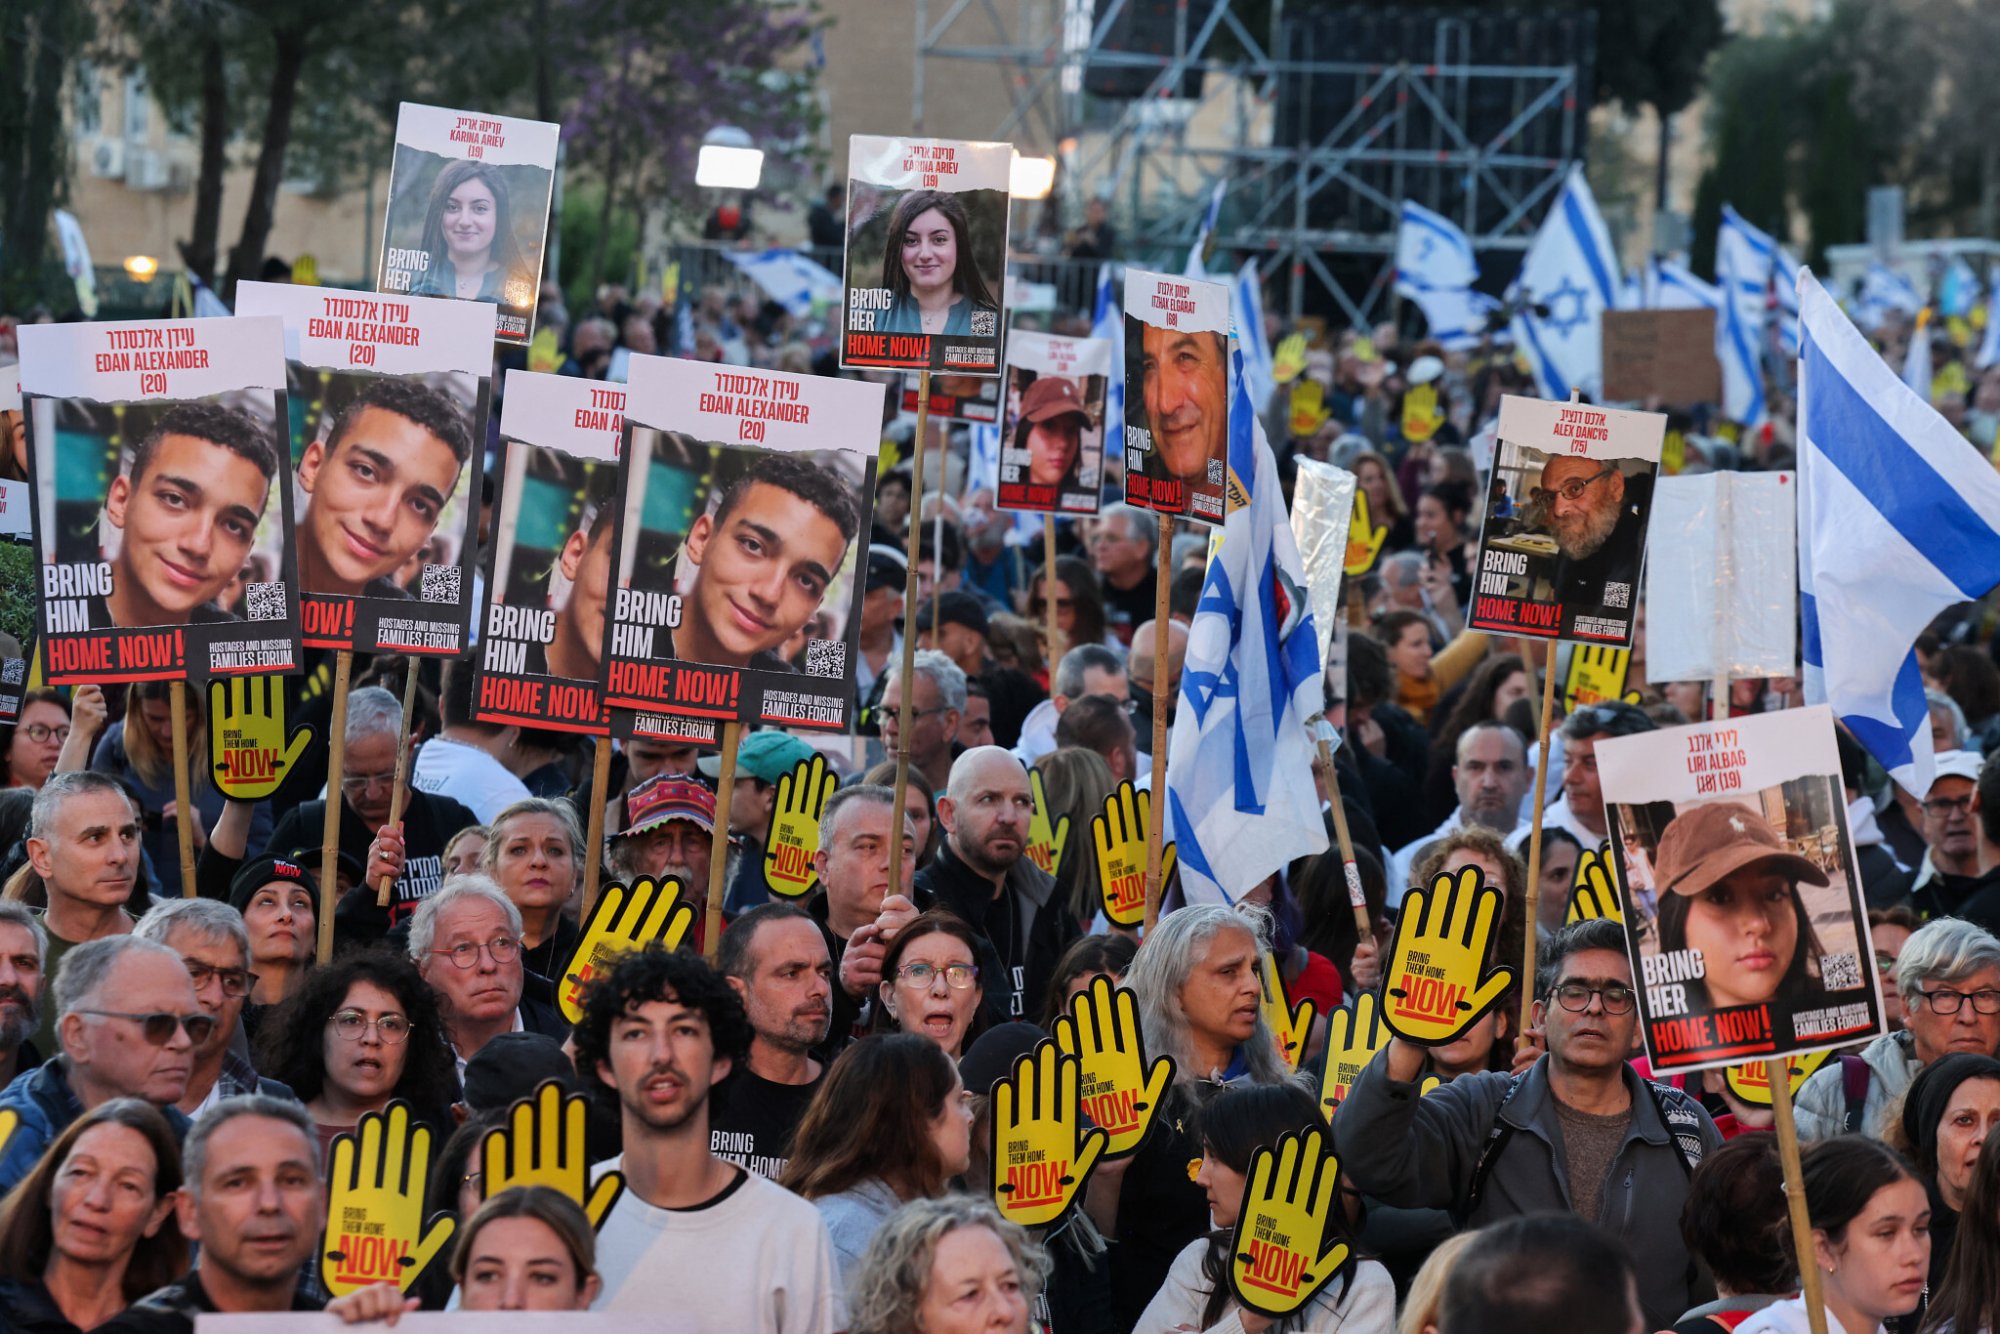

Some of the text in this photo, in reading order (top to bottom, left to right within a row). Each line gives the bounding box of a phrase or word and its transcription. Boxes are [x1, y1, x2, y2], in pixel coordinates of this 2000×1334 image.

[449, 129, 505, 148] KARINA ARIEV
[468, 144, 483, 159] (19)
[903, 159, 958, 174] KARINA ARIEV
[923, 173, 938, 188] (19)
[387, 247, 429, 271] BRING
[384, 269, 411, 291] HER
[850, 287, 892, 310] BRING
[324, 298, 409, 323] עידן אלכסנדר
[849, 310, 875, 331] HER
[106, 328, 195, 349] עידן אלכסנדר
[308, 318, 420, 346] EDAN ALEXANDER
[350, 344, 376, 366] (20)
[847, 334, 930, 359] HOME NOW!
[95, 349, 209, 372] EDAN ALEXANDER
[945, 353, 995, 364] FAMILIES FORUM
[140, 373, 167, 395] (20)
[714, 372, 799, 401] עידן אלכסנדר
[590, 389, 627, 411] כסנדר
[699, 393, 810, 424] EDAN ALEXANDER
[574, 408, 607, 431] EDAN
[739, 419, 765, 442] (20)
[1127, 425, 1151, 451] BRING
[1553, 423, 1608, 441] ALEX DANCYG
[1571, 439, 1587, 454] (75)
[1127, 447, 1143, 472] HIM
[1128, 472, 1182, 504] HOME NOW!
[1483, 550, 1528, 575] BRING
[42, 562, 113, 598] BRING
[1479, 572, 1509, 596] HIM
[46, 599, 90, 633] HIM
[614, 588, 683, 628] BRING
[1476, 596, 1562, 627] HOME NOW!
[378, 617, 460, 634] HOSTAGES AND MISSING
[487, 604, 556, 644] BRING
[47, 629, 185, 672] HOME NOW!
[209, 638, 291, 653] HOSTAGES AND MISSING
[377, 628, 459, 650] FAMILIES FORUM
[610, 623, 654, 659] HIM
[210, 649, 293, 669] FAMILIES FORUM
[483, 639, 527, 675] HIM
[480, 676, 544, 715] HOME
[607, 660, 740, 708] HOME NOW!
[763, 689, 844, 708] HOSTAGES AND MISSING
[762, 701, 843, 724] FAMILIES FORUM
[223, 730, 242, 739] BRING
[634, 717, 679, 735] FAMILIES
[680, 721, 715, 739] FORUM
[1715, 729, 1738, 748] לירי
[224, 739, 258, 749] THEM HOME
[224, 748, 278, 778] NOW
[1687, 749, 1746, 773] LIRI ALBAG
[1719, 769, 1741, 791] (19)
[771, 843, 816, 878] NOW
[1025, 841, 1052, 869] OW
[275, 863, 301, 878] NOW
[1407, 950, 1430, 964] BRING
[1640, 948, 1705, 986] BRING
[1405, 962, 1446, 979] THEM HOME
[1396, 974, 1467, 1018] NOW
[1645, 983, 1689, 1018] HER
[1652, 1004, 1772, 1053] HOME NOW!
[1794, 1012, 1871, 1038] FAMILIES FORUM
[1081, 1072, 1096, 1085] RING
[1338, 1062, 1360, 1074] BRING
[1081, 1080, 1115, 1097] HEM HOME
[1081, 1088, 1138, 1128] NOW
[711, 1130, 754, 1153] BRING
[1008, 1140, 1028, 1153] BRING
[1008, 1150, 1045, 1165] THEM HOME
[1007, 1160, 1067, 1200] NOW
[343, 1207, 367, 1220] BRING
[1256, 1213, 1277, 1229] BRING
[342, 1222, 385, 1236] THEM HOME
[1254, 1226, 1291, 1248] THEM HOME
[336, 1235, 409, 1278] NOW
[1244, 1239, 1309, 1290] NOW
